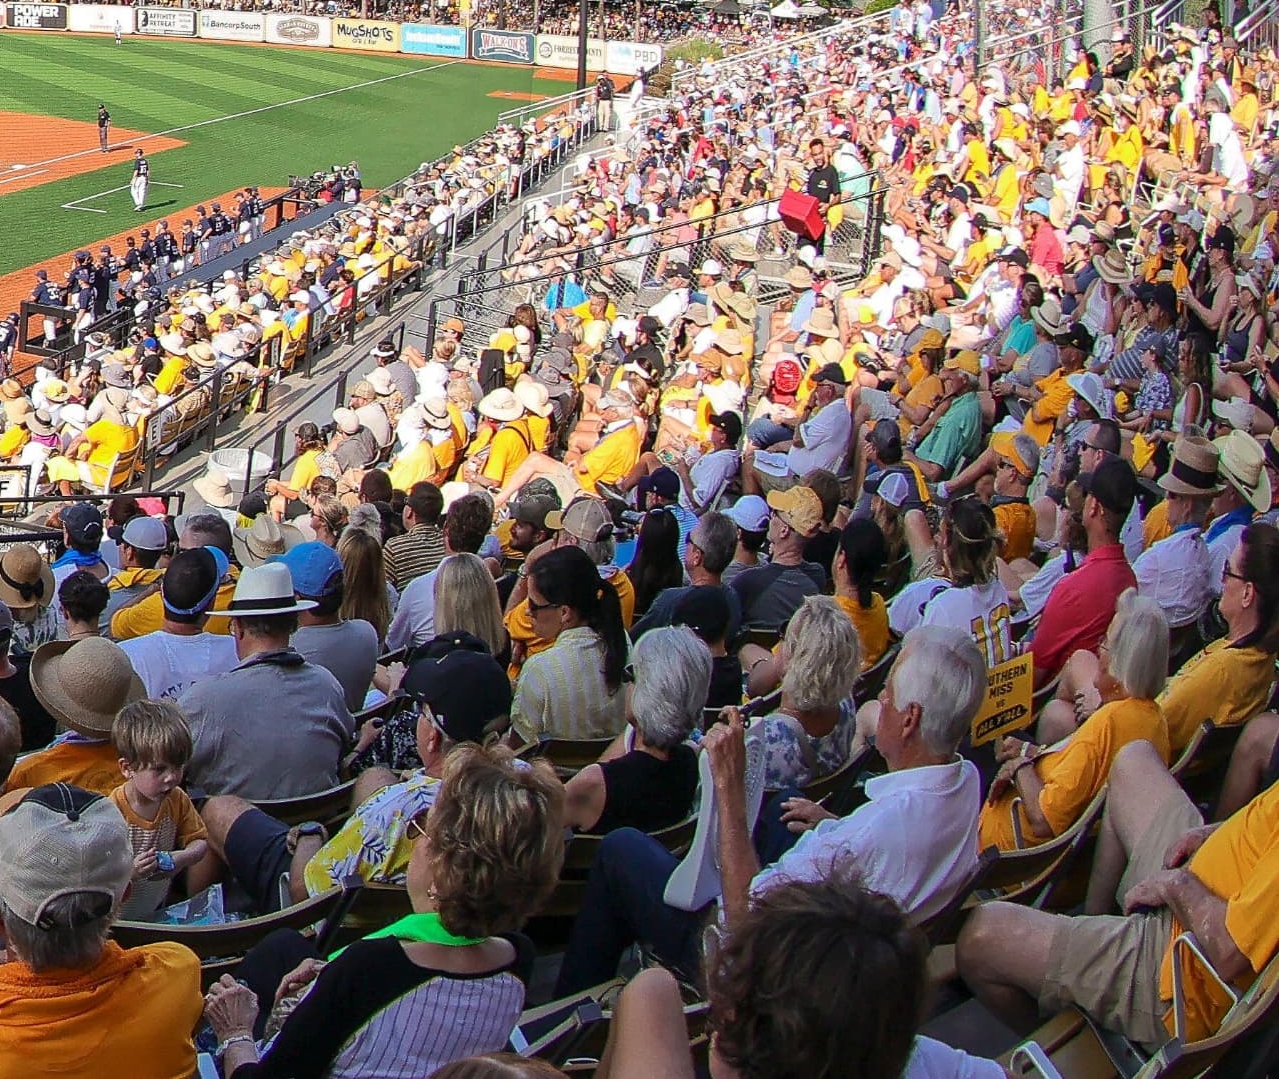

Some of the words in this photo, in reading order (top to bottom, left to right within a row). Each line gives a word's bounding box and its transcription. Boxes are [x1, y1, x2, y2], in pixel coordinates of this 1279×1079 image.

[14, 6, 59, 18] POWER
[14, 16, 42, 27] ADE
[210, 20, 261, 30] BancorpSouth
[634, 50, 657, 63] PBD
[151, 425, 157, 440] E
[988, 663, 1027, 686] UTHERN
[989, 682, 1013, 699] MISS
